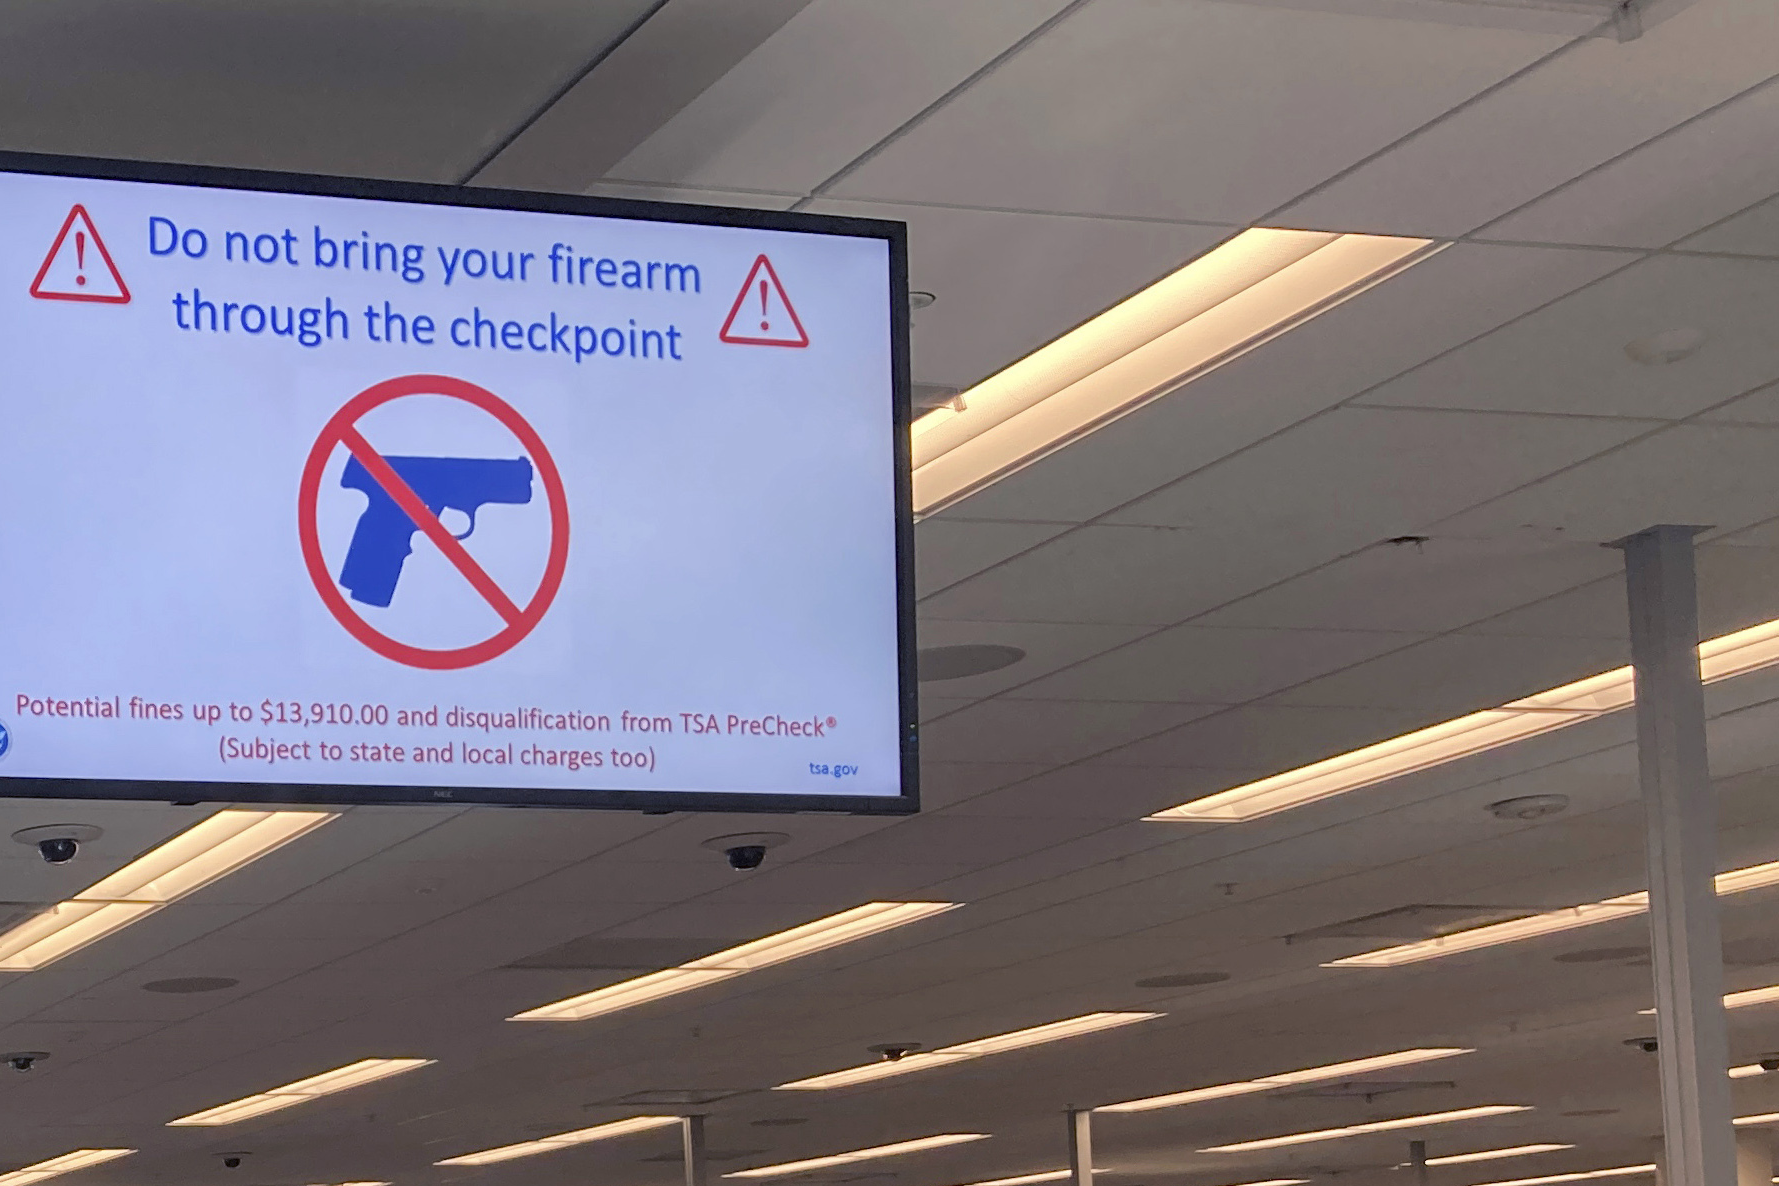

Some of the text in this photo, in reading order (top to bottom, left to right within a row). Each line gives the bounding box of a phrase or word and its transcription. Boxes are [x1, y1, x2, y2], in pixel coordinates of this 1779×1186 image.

[149, 216, 701, 293] Do not bring your firearm
[172, 288, 682, 363] through the checkpoint
[16, 695, 120, 719] Potential
[129, 696, 184, 720] fines
[193, 704, 222, 726] up
[230, 702, 253, 722] to
[260, 699, 389, 726] $13,910.00
[397, 704, 438, 727] and
[446, 706, 610, 732] disqualification
[621, 711, 673, 732] from
[679, 713, 720, 734] TSA
[219, 737, 656, 772] (Subject to state and local charges too)
[809, 762, 859, 779] tsa.gov
